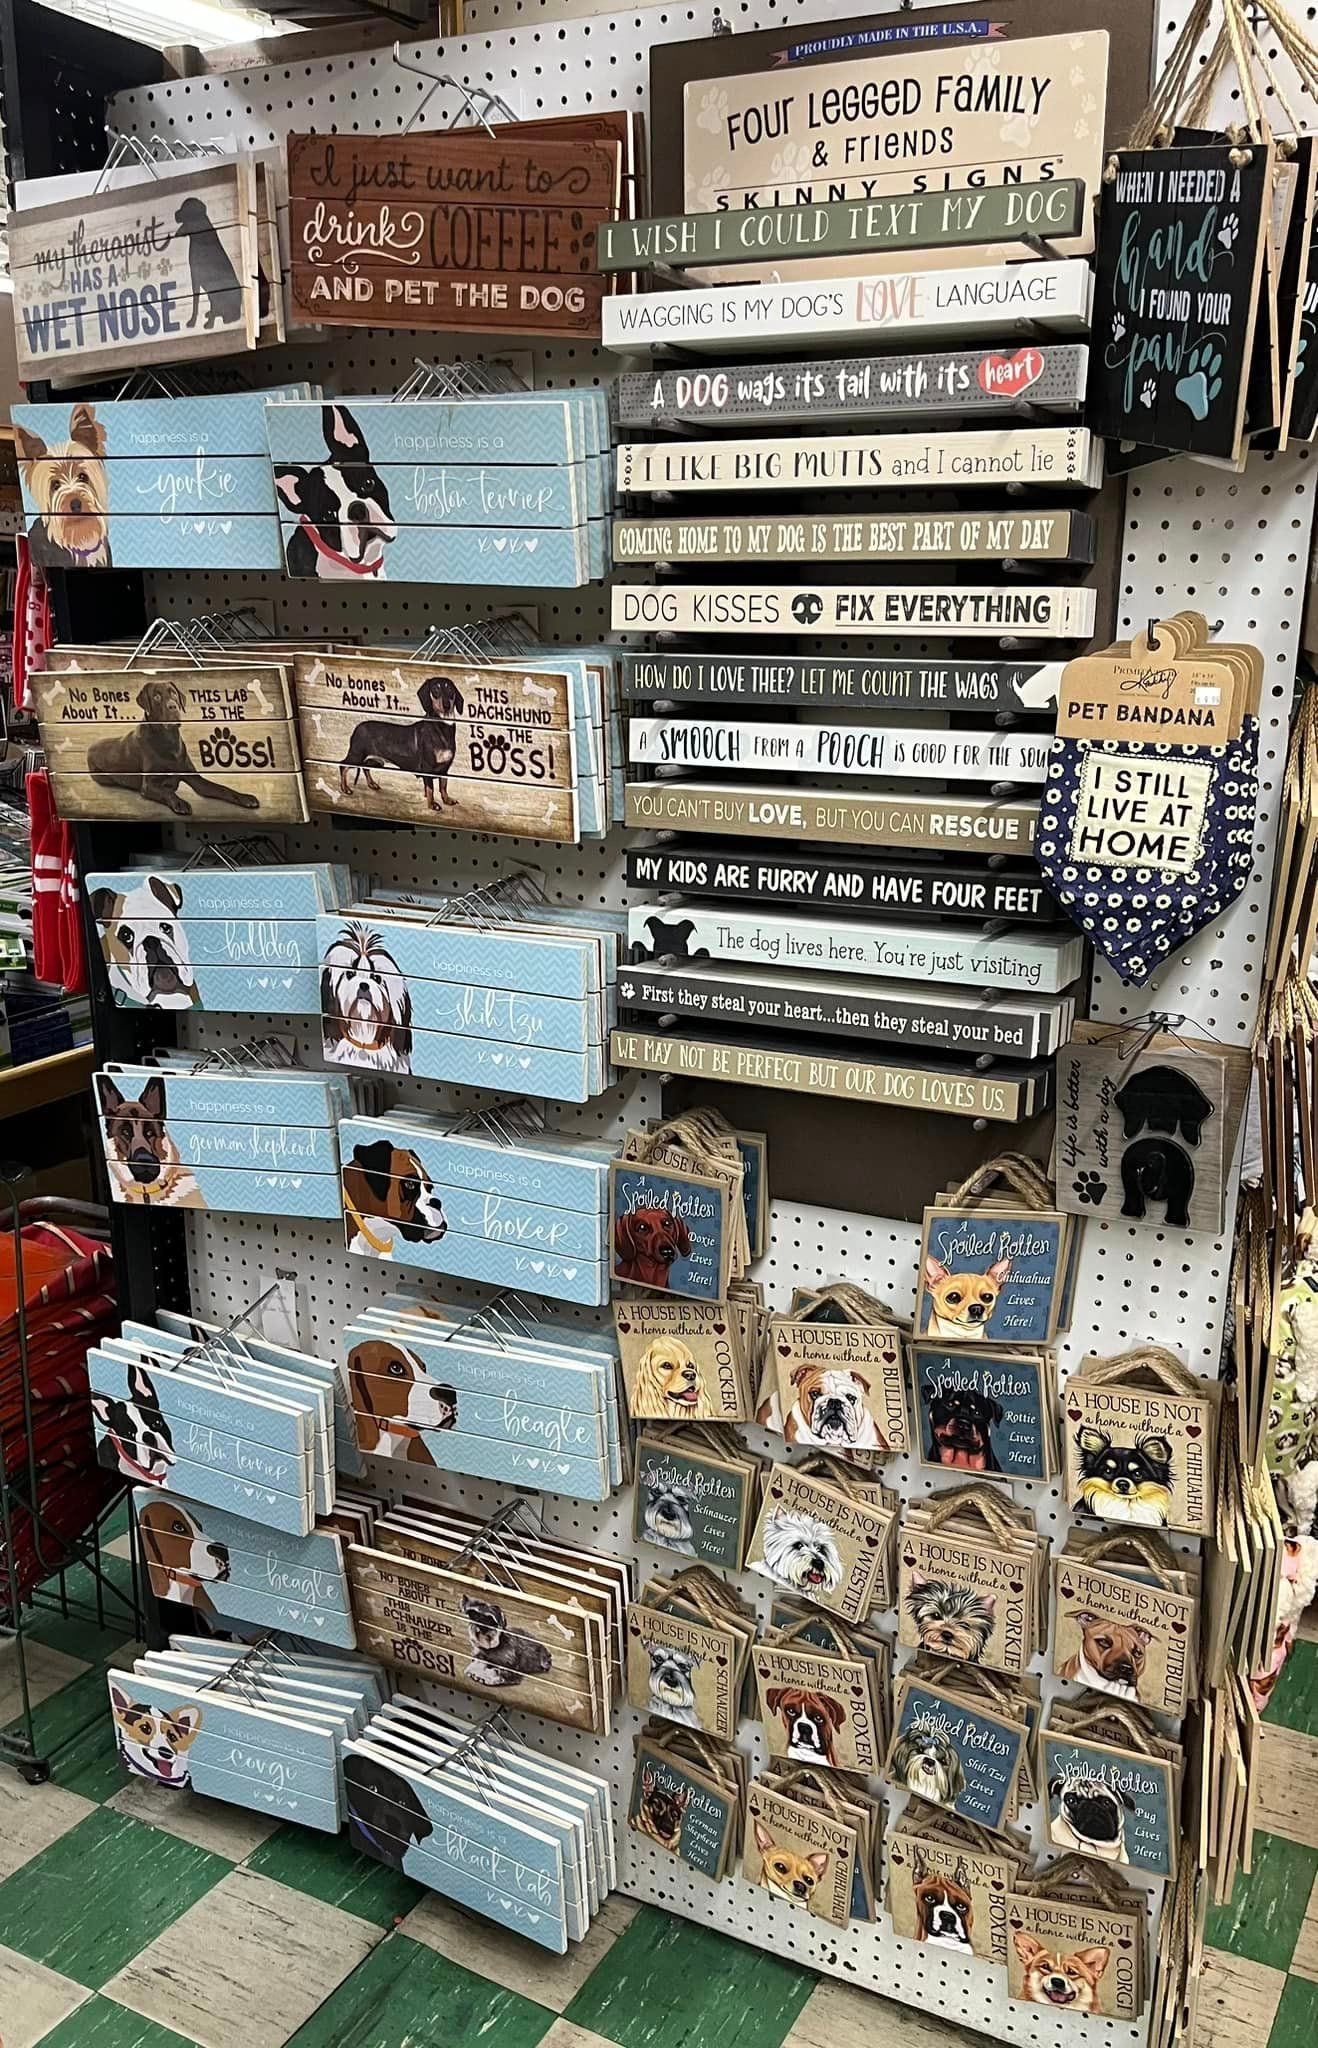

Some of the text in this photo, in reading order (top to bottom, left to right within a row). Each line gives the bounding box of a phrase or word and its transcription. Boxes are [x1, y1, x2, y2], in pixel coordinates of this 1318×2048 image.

[795, 23, 981, 56] PROUDLY MADE IN THE U.S.A.
[812, 141, 828, 167] &
[311, 145, 590, 205] I just want to
[716, 162, 1057, 212] SKINNY SIGNS
[1116, 169, 1240, 203] WHEN I NEEDED A
[303, 202, 563, 272] drink COFFEE
[607, 187, 1068, 258] I WISH I COULD TEXT MY DOG
[34, 216, 171, 290] my therapist
[1113, 206, 1234, 312] hand
[71, 264, 117, 293] HAS A
[311, 277, 584, 312] AND PET THE DOG
[23, 282, 180, 353] WET NOSE
[619, 276, 1057, 330] WAGGING IS MY DOG'S LOVE LANGUAGE
[1140, 289, 1231, 325] I FOUND YOUR
[651, 352, 1037, 409] A DOG wags its tail with its heart
[1105, 323, 1227, 413] paw
[395, 433, 504, 452] happiness is a
[644, 444, 1054, 481] I LIKE BIG MUTTS and I cannot lie
[137, 446, 237, 524] yorkie
[405, 467, 471, 517] boston
[619, 520, 1054, 555] COMING HOME TO MY DOG IS THE BEST PART OF MY DAY
[625, 594, 1050, 623] DOG KISSES FIX EVERYTHING
[62, 705, 136, 720] About It...
[69, 688, 130, 703] No Bones
[189, 689, 247, 703] THIS LAB
[202, 706, 245, 720] IS THE
[468, 704, 551, 724] DACHSHUND
[1068, 702, 1216, 727] PET BANDANA
[199, 736, 276, 768] BOSS!
[1095, 767, 1189, 798] I STILL
[1088, 798, 1192, 828] LIVE AT
[1079, 829, 1190, 862] HOME
[636, 858, 1042, 913] MY KIDS ARE FURRY AND HAVE FOUR FEET
[717, 927, 1042, 984] The dog lives here. You're just visiting
[448, 1161, 541, 1189] happiness is a
[938, 1232, 1049, 1266] Spoiled Rotten
[997, 1271, 1050, 1284] Chihuahua
[618, 1306, 723, 1320] A HOUSE IS NOT
[1008, 1294, 1035, 1305] Lives
[1004, 1315, 1032, 1327] Here!
[714, 1340, 737, 1411] COCKER
[475, 1389, 590, 1455] beagle
[883, 1367, 904, 1443] BULLDOG
[1005, 1411, 1036, 1424] Rottie
[1068, 1391, 1201, 1422] A HOUSE IS NOT
[1187, 1443, 1202, 1522] CHIHUAHUA
[1004, 1599, 1023, 1669] YORKIE
[1164, 1637, 1185, 1707] PITBULL
[850, 1700, 872, 1766] BOXER
[1135, 1808, 1156, 1824] Pug
[1117, 1957, 1133, 2010] CORGI
